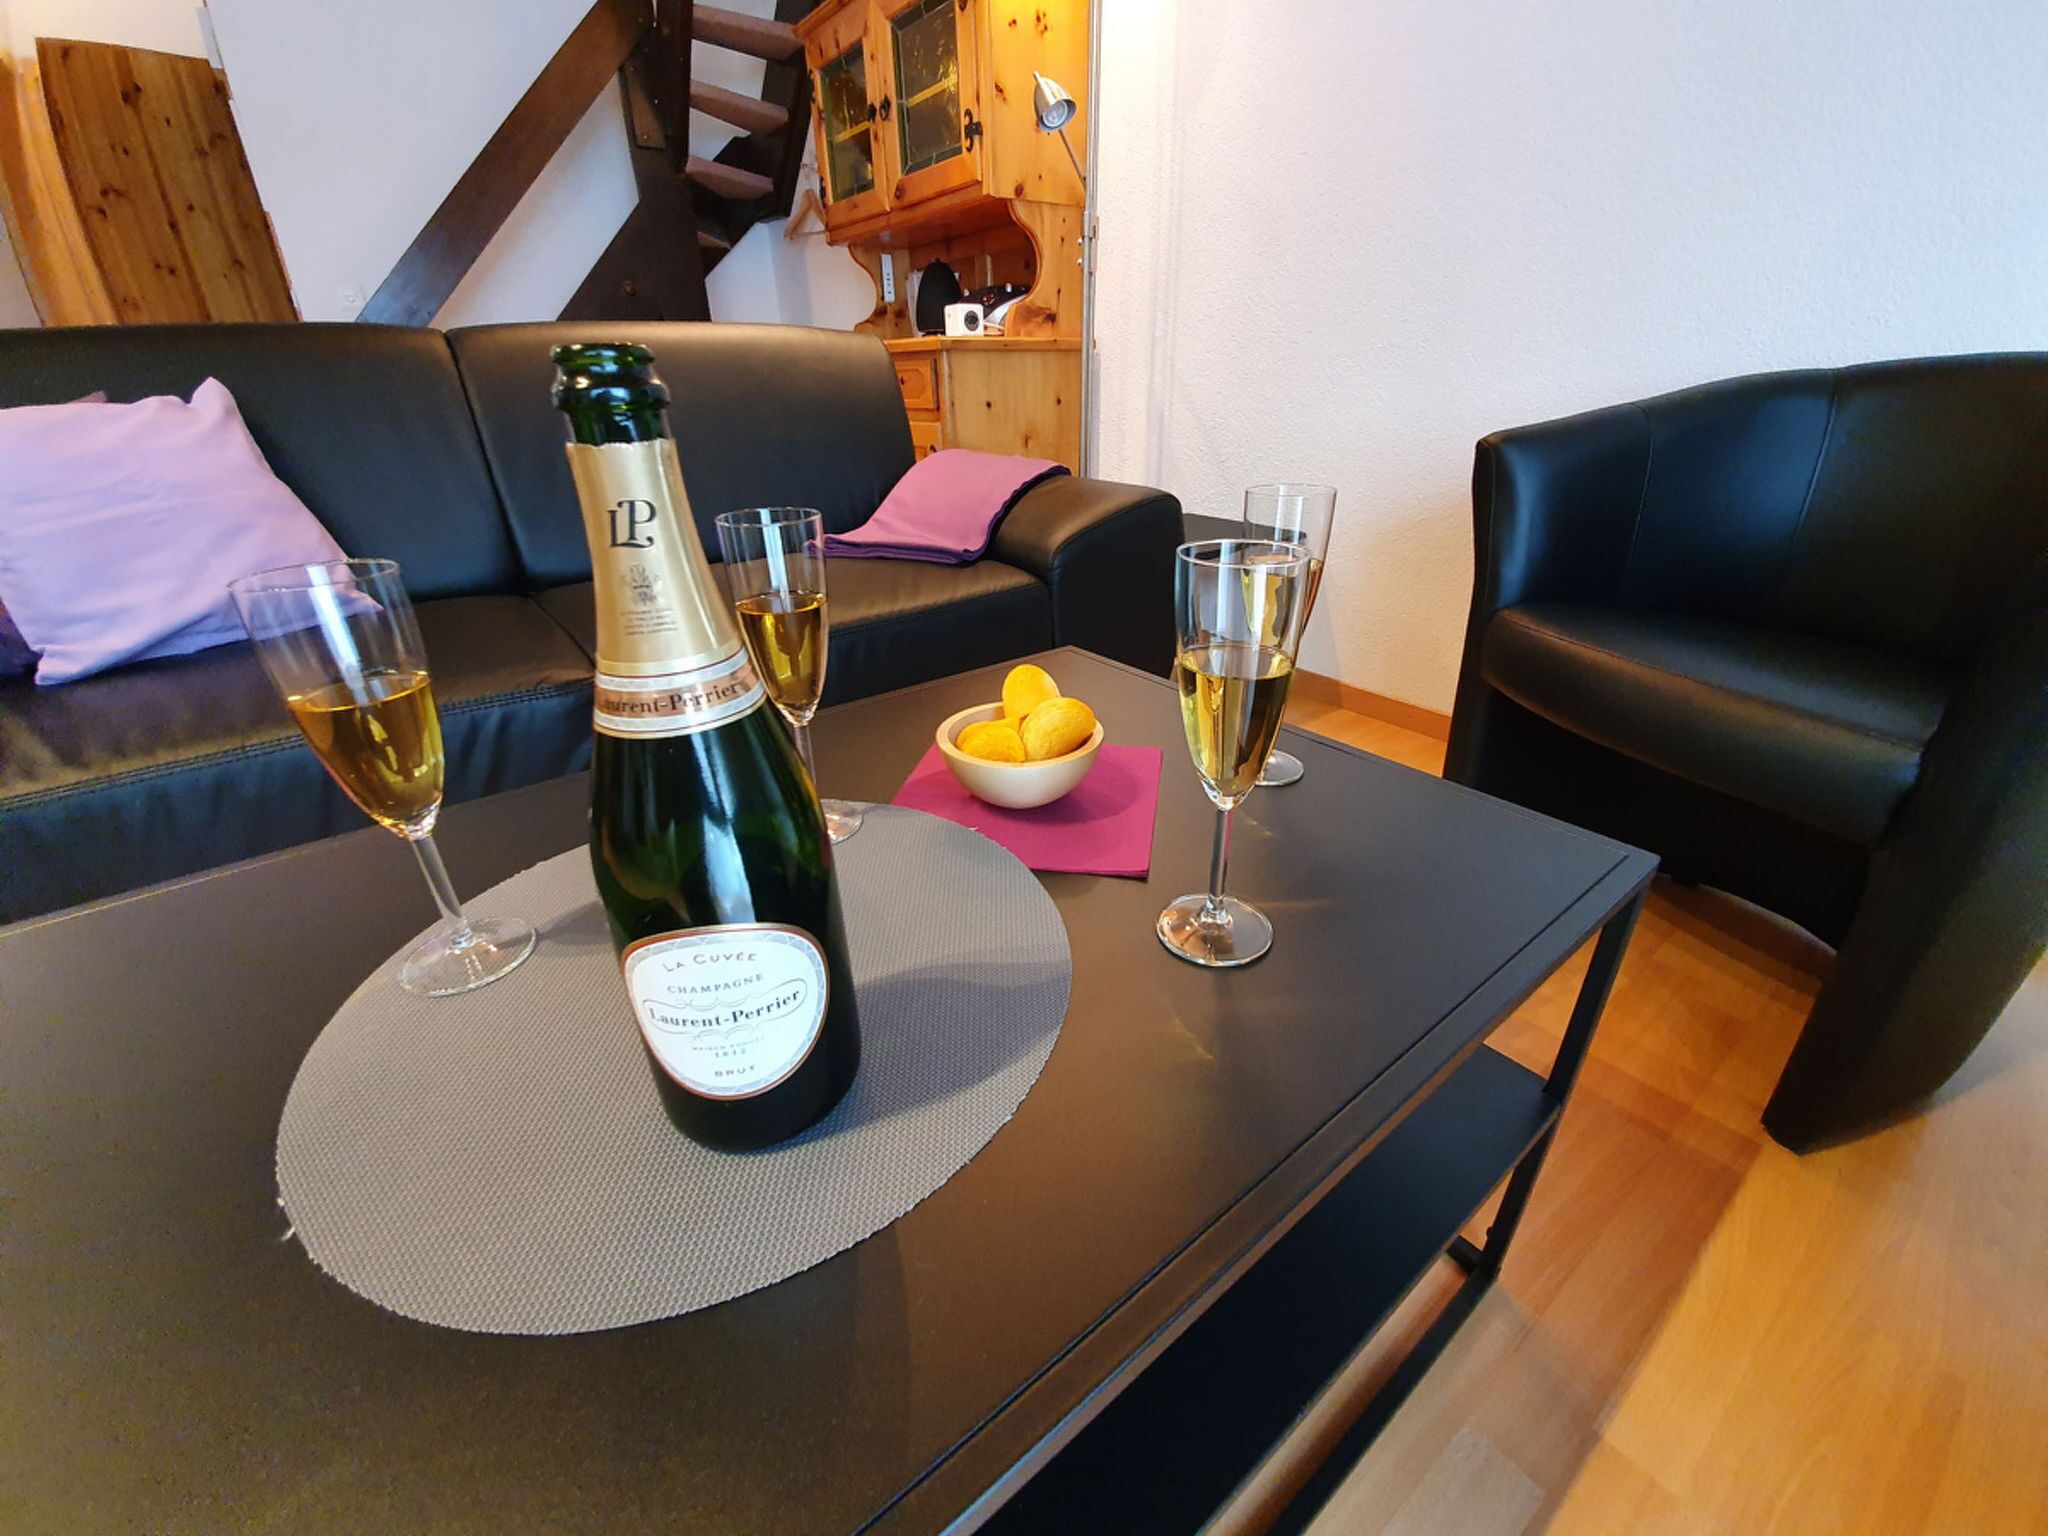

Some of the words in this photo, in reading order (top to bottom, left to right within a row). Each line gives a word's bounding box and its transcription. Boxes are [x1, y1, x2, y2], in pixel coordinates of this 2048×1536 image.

[606, 499, 657, 549] LP
[604, 681, 741, 714] aurent-Perrier
[662, 961, 685, 973] LA
[692, 951, 758, 965] CUVÉE
[667, 972, 764, 995] CHAMPAGNE
[649, 989, 801, 1027] Laurent-Perrier
[714, 1064, 757, 1078] BRUT
